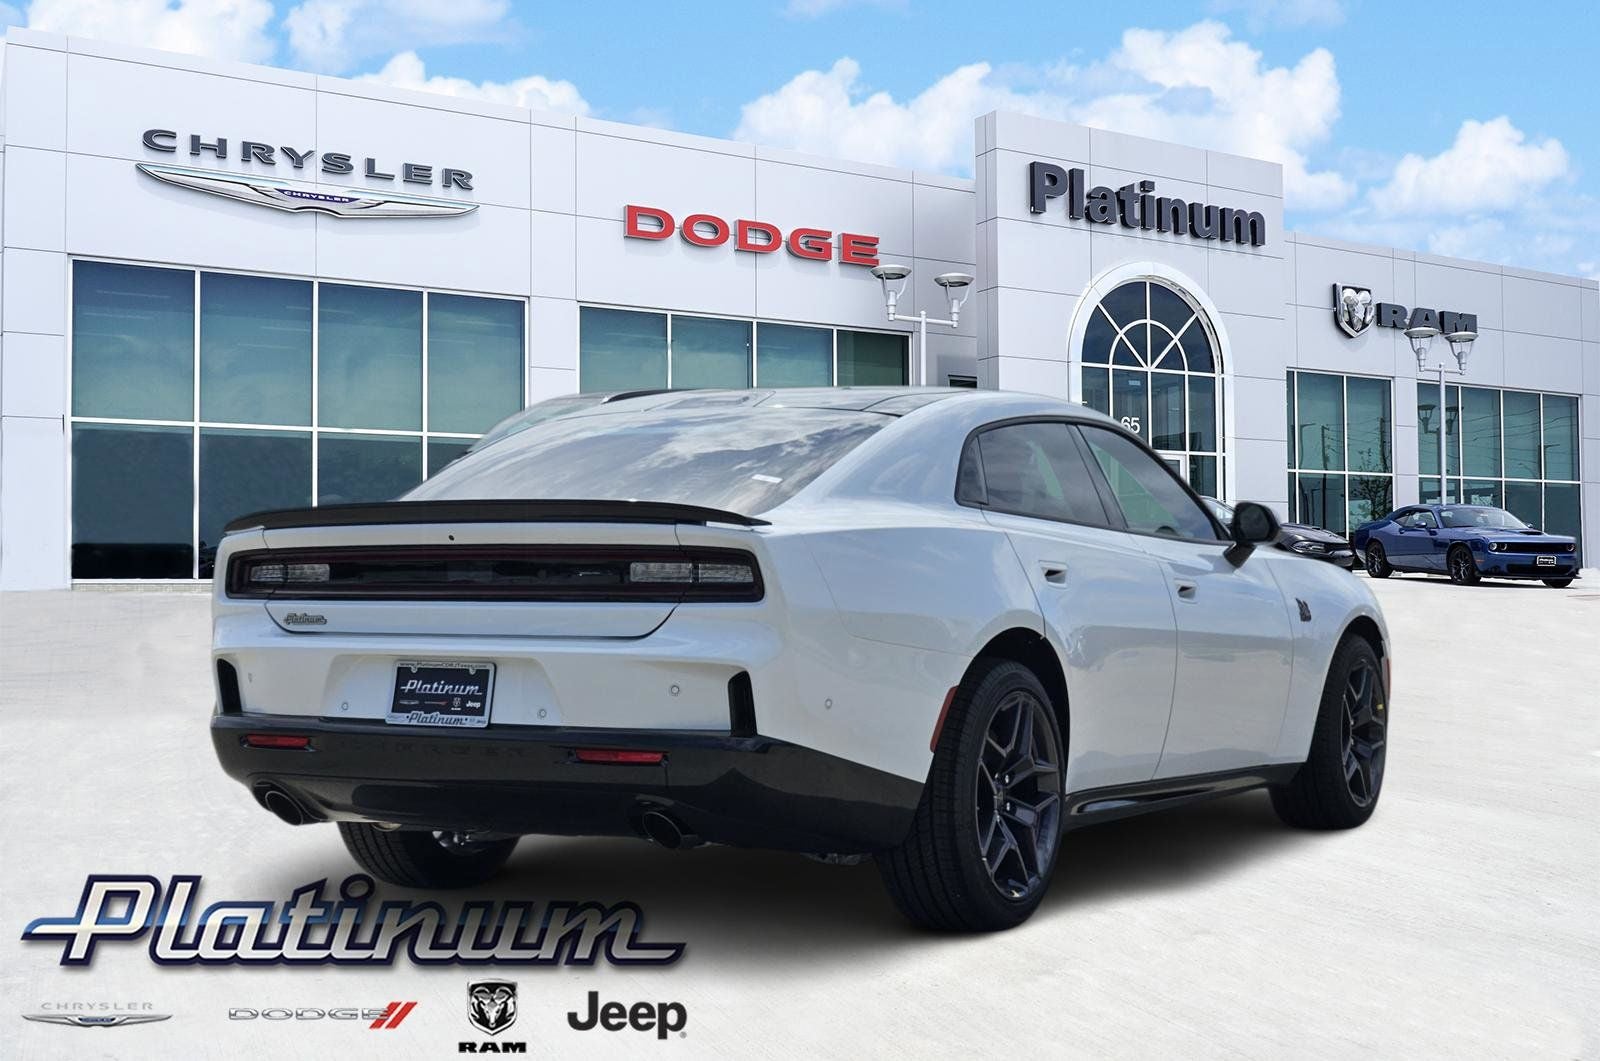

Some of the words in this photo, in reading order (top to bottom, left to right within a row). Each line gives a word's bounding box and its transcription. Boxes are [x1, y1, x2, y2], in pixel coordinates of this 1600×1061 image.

[142, 128, 474, 190] CHRYSLER
[283, 190, 350, 203] CHRYSLER
[1029, 160, 1266, 246] Platinum
[623, 204, 880, 267] DODGE
[1376, 302, 1478, 335] RAM
[400, 680, 482, 695] Platinum
[466, 700, 481, 709] Jeep
[408, 711, 467, 726] Platinum
